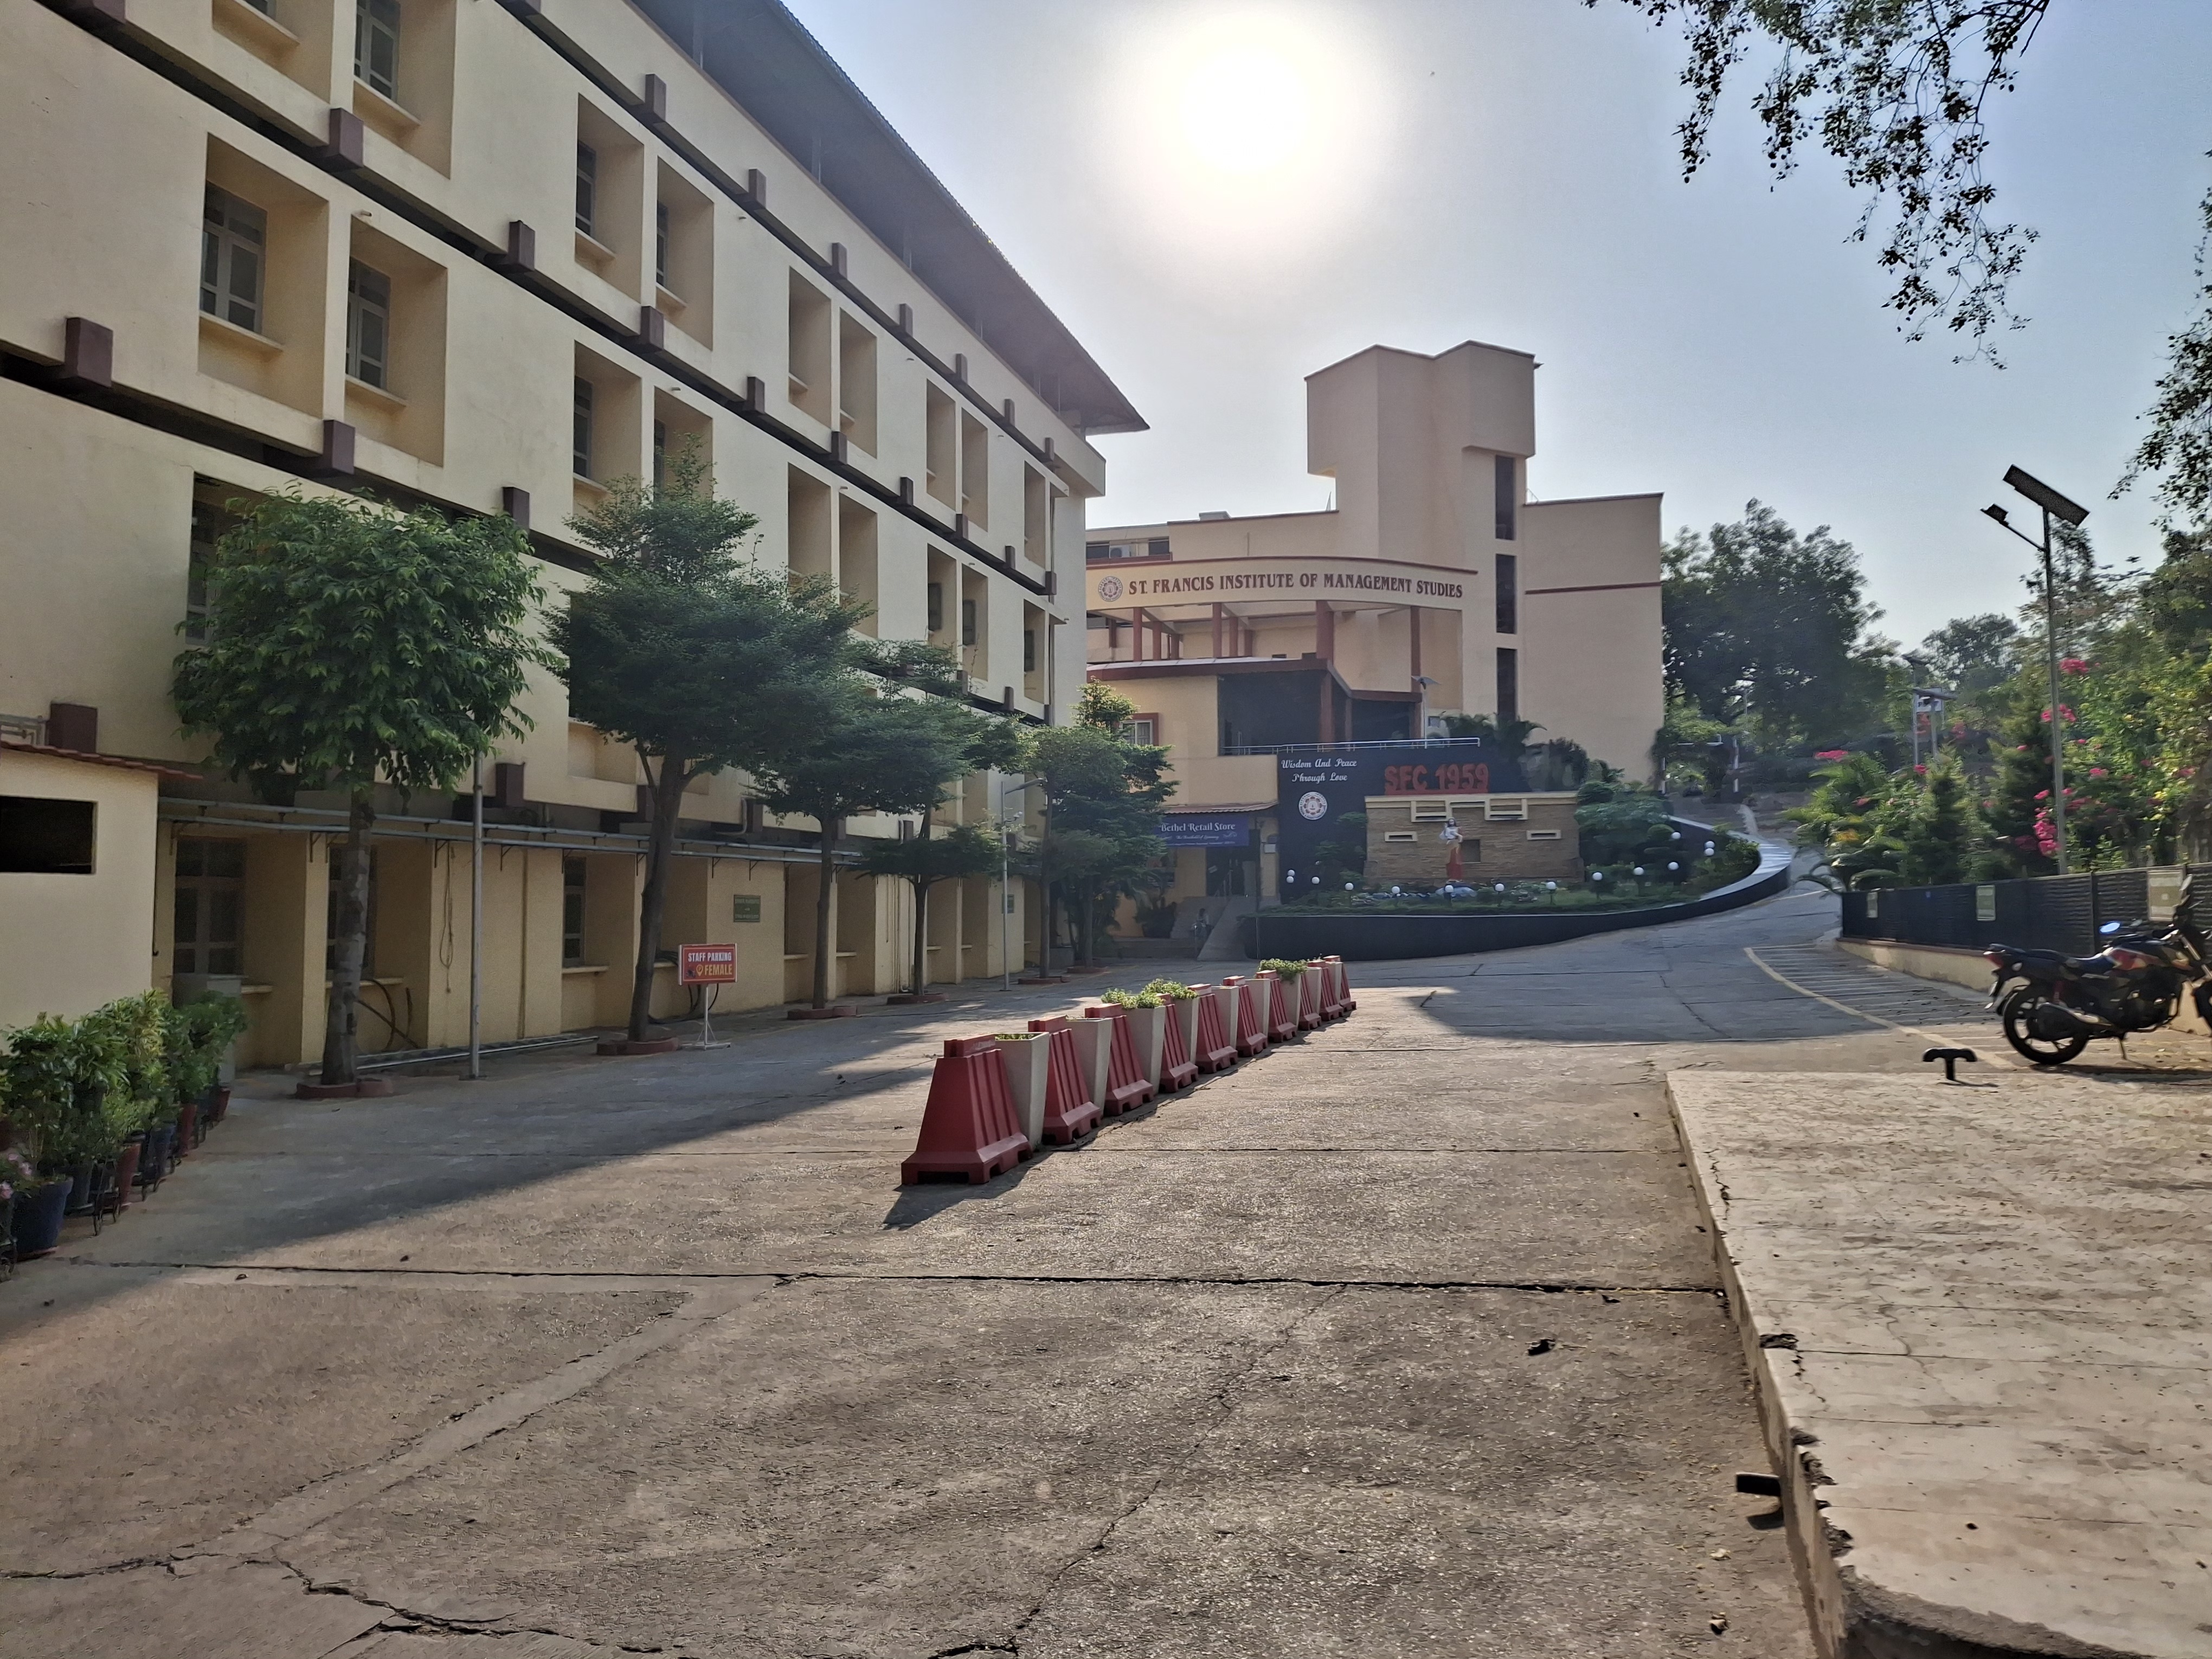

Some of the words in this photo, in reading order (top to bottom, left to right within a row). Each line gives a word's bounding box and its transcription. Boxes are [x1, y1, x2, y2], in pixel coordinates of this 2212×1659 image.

[1129, 580, 1148, 595] ST.
[1153, 576, 1214, 593] FRANCIS
[1220, 574, 1294, 590] INSTITUTE
[1300, 573, 1317, 587] OF
[1323, 574, 1412, 593] MANAGEMENT
[1416, 580, 1462, 598] STUDIES
[1281, 759, 1311, 769] Wisdom
[1315, 758, 1332, 768] And
[1334, 758, 1357, 767] Peace
[1291, 773, 1326, 784] Through
[1329, 772, 1348, 781] Love
[1385, 764, 1427, 791] SFC
[1435, 763, 1489, 790] 1959
[1161, 822, 1186, 832] Bethel
[1188, 822, 1213, 832] Retail
[1214, 822, 1236, 832] Store
[688, 952, 706, 962] STAFF
[707, 951, 732, 962] PARKING
[705, 964, 732, 976] FEMALE
